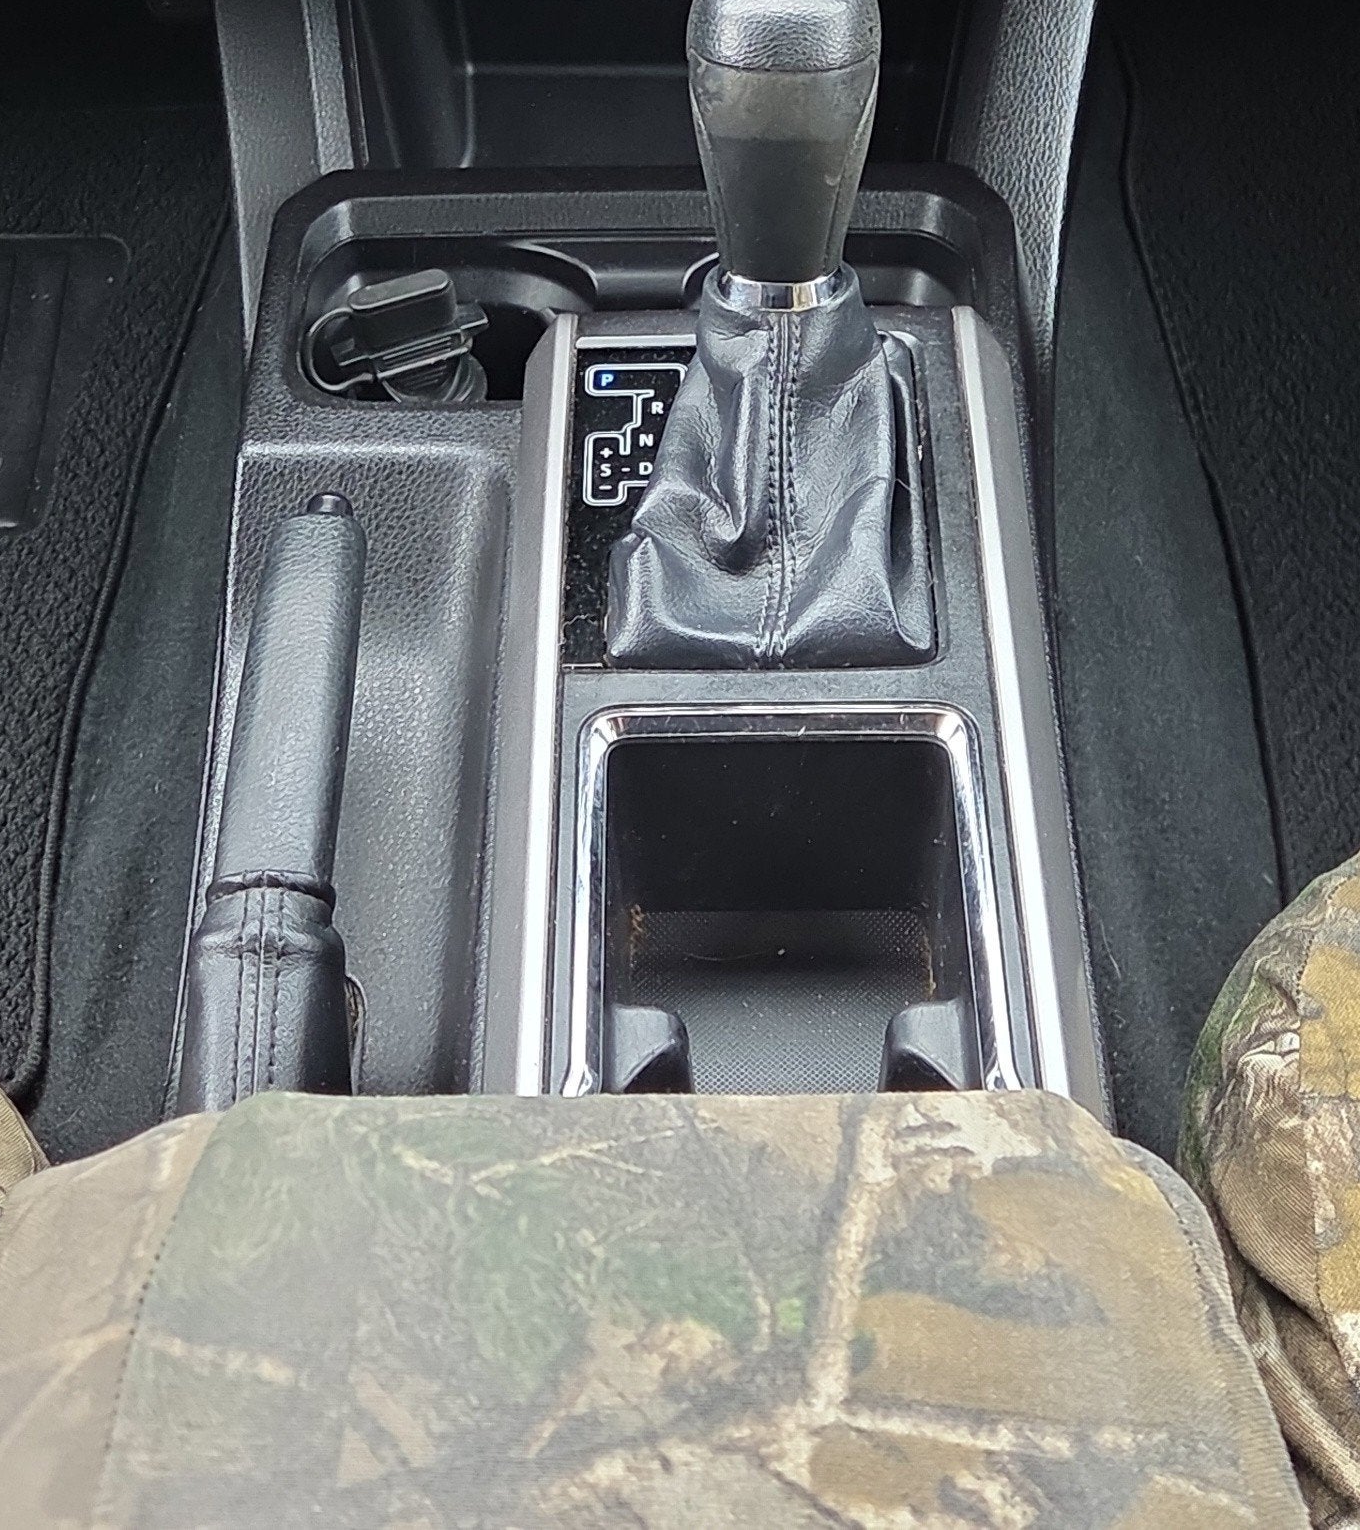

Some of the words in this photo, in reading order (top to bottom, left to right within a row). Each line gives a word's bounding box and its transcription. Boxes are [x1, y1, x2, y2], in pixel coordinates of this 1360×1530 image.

[600, 373, 614, 387] P
[651, 401, 664, 415] R
[639, 433, 654, 447] N
[600, 463, 612, 477] S
[638, 461, 653, 475] D
